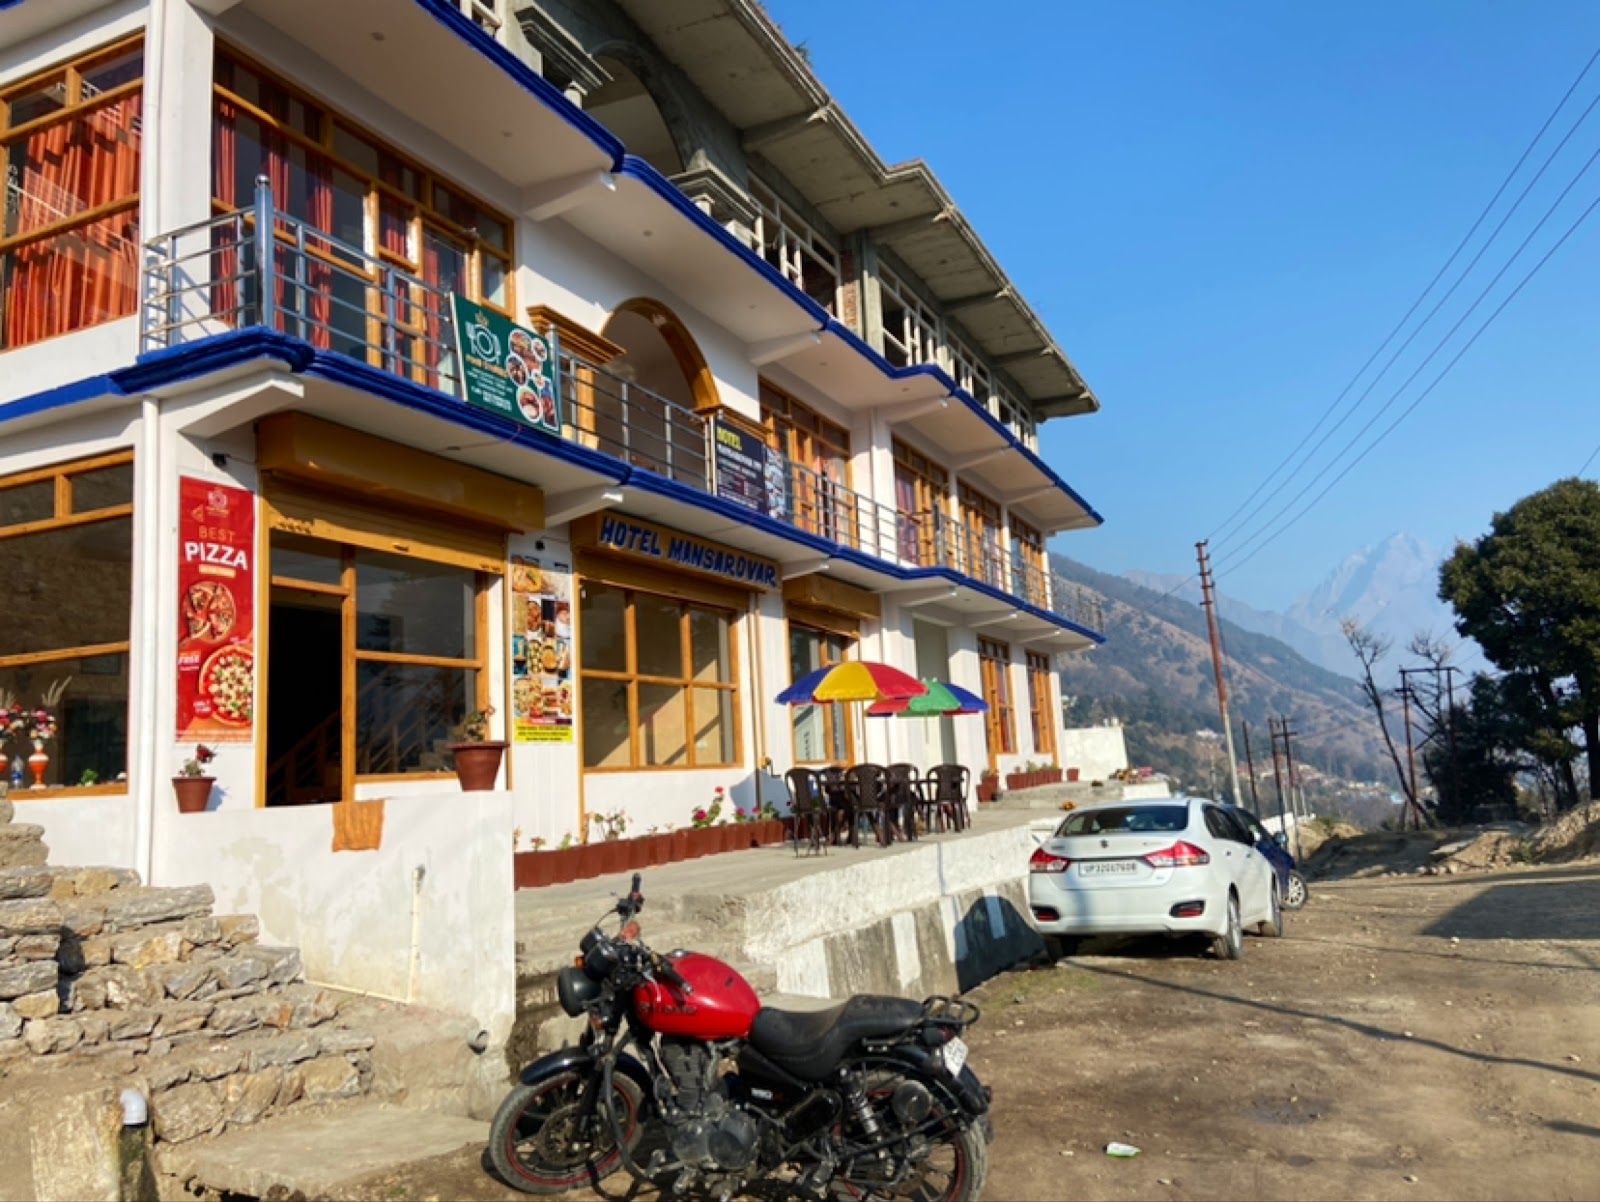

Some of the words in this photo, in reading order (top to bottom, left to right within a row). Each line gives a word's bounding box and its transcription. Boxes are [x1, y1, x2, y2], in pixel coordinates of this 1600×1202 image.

[198, 525, 236, 542] BEST
[184, 540, 249, 571] PIZZA
[600, 516, 662, 557] HOTEL
[667, 536, 777, 588] MANSAROVAR
